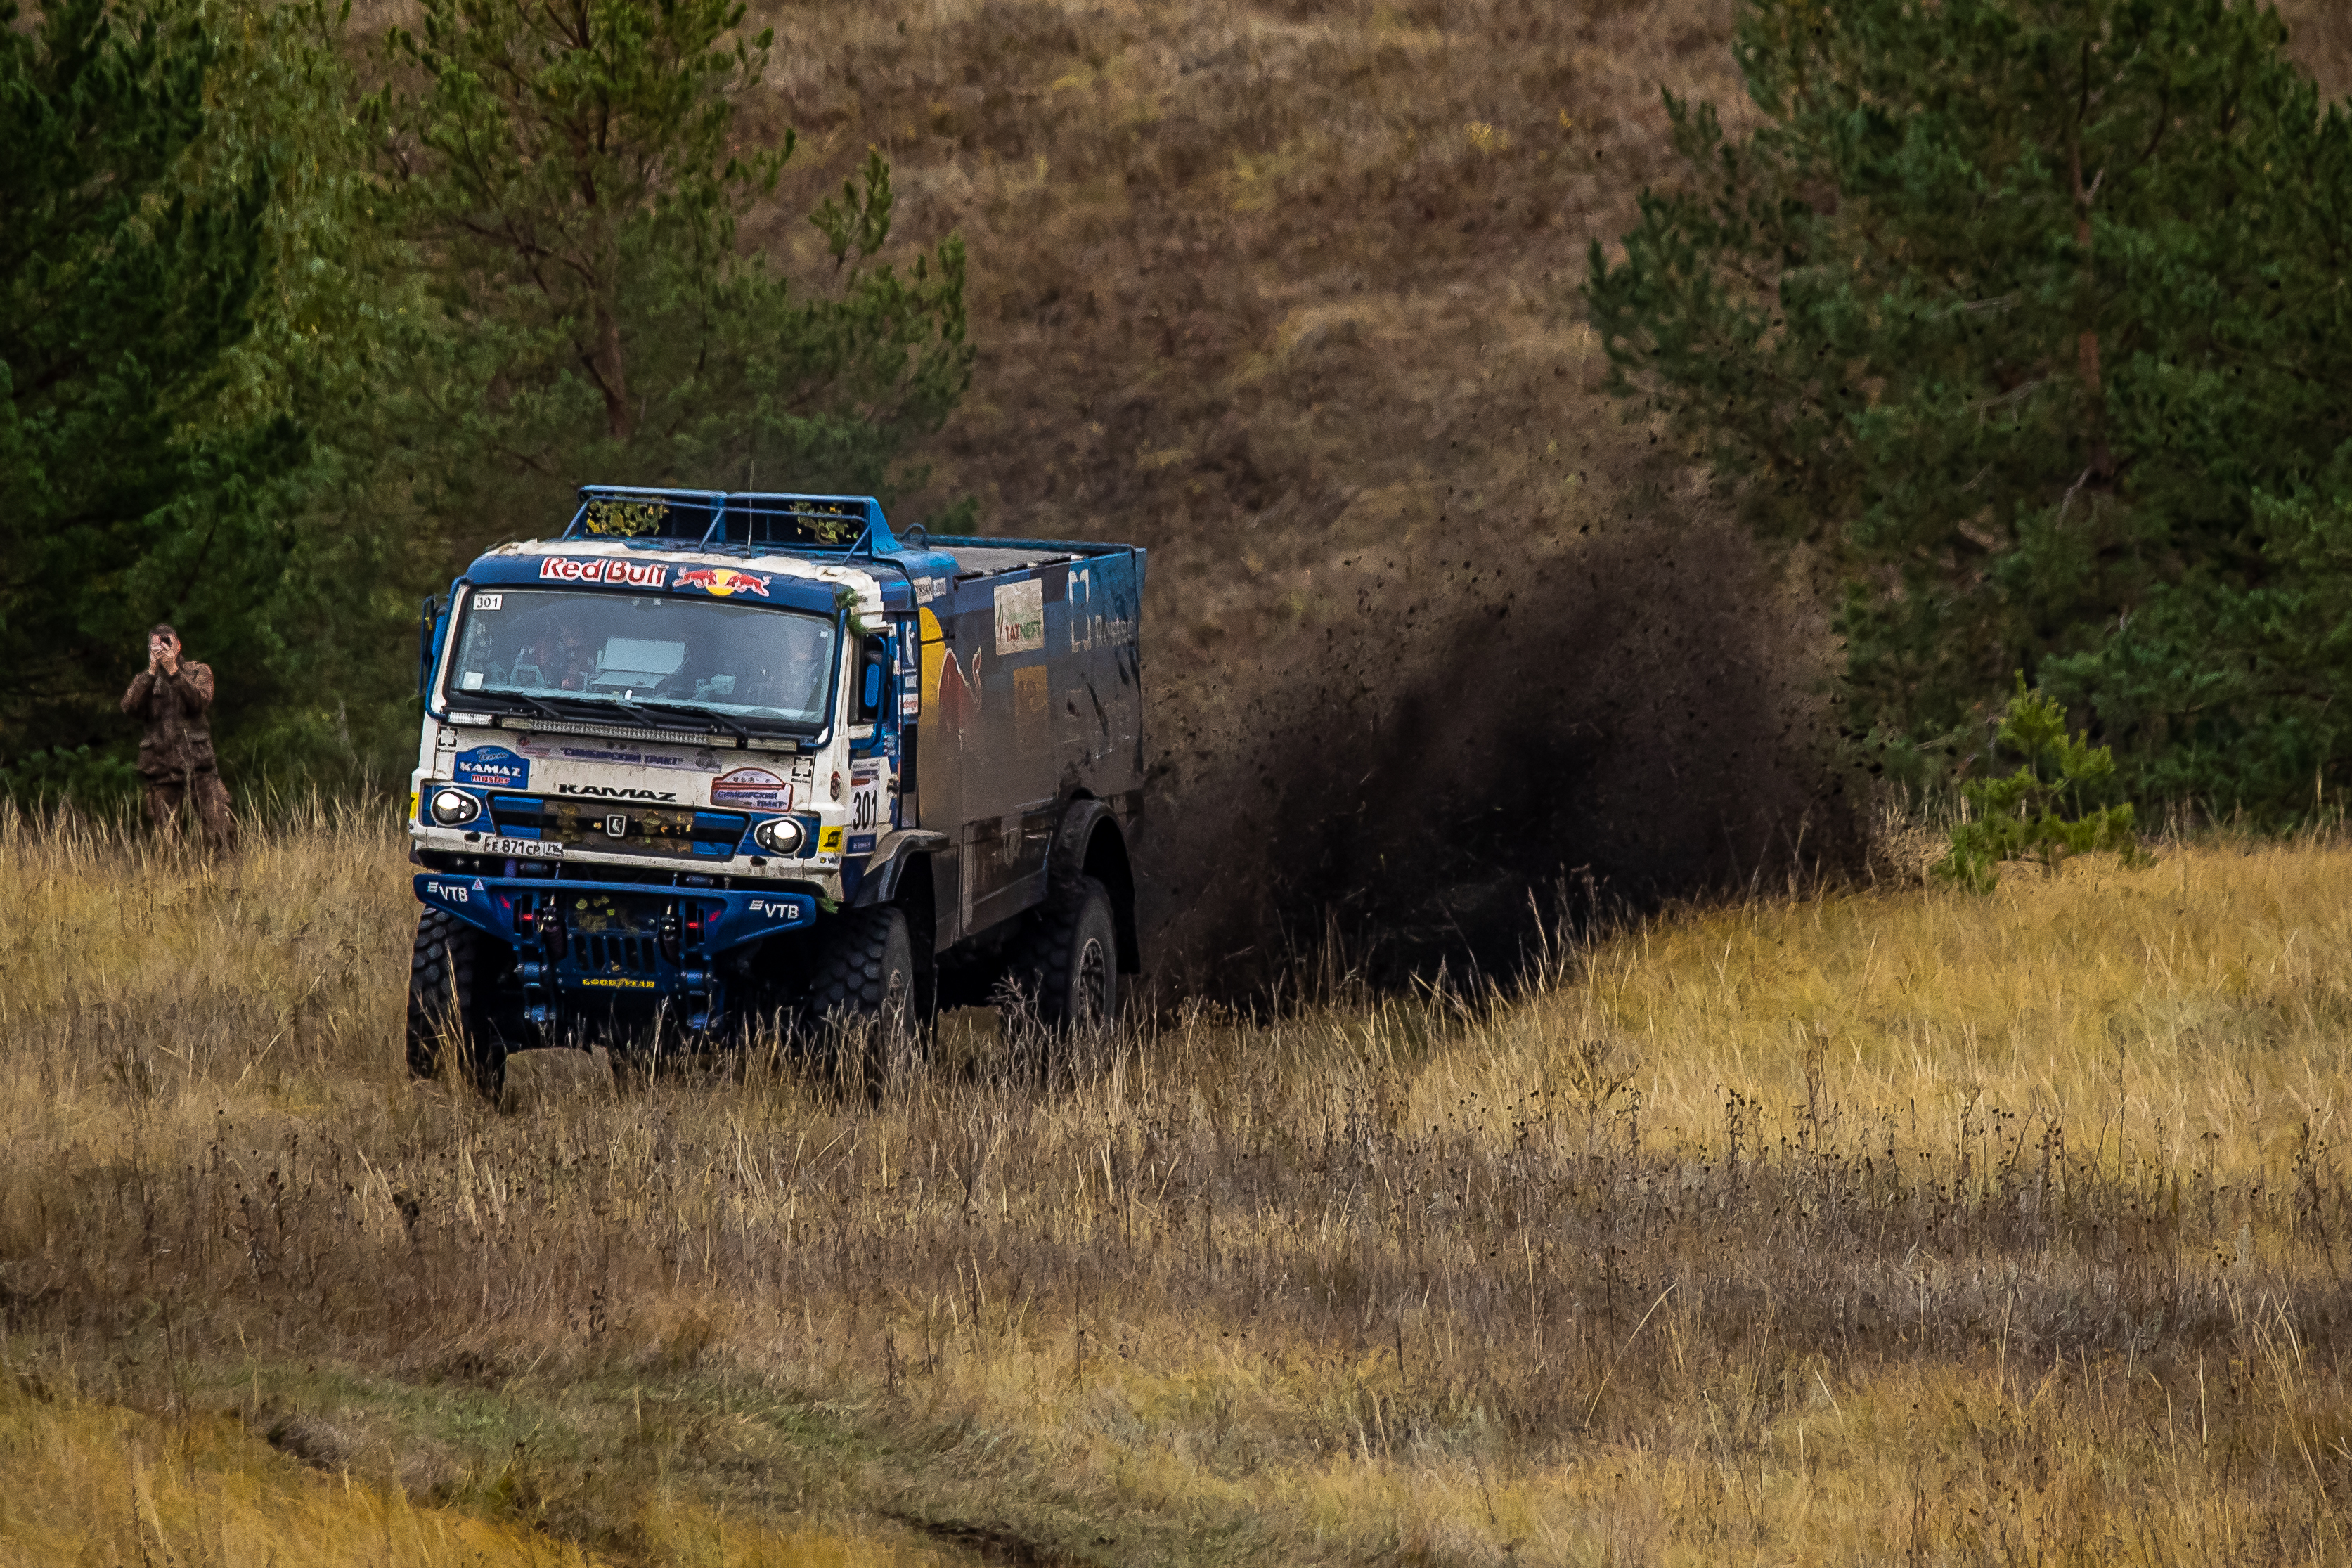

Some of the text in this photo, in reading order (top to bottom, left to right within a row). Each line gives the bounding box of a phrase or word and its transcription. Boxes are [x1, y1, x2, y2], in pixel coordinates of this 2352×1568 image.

[540, 557, 665, 587] Red Bull
[476, 597, 498, 609] 301
[460, 761, 522, 777] KAMAZ
[558, 783, 677, 803] KAMAZ
[852, 789, 877, 831] 301
[439, 886, 468, 902] VTB
[765, 903, 799, 919] VTB
